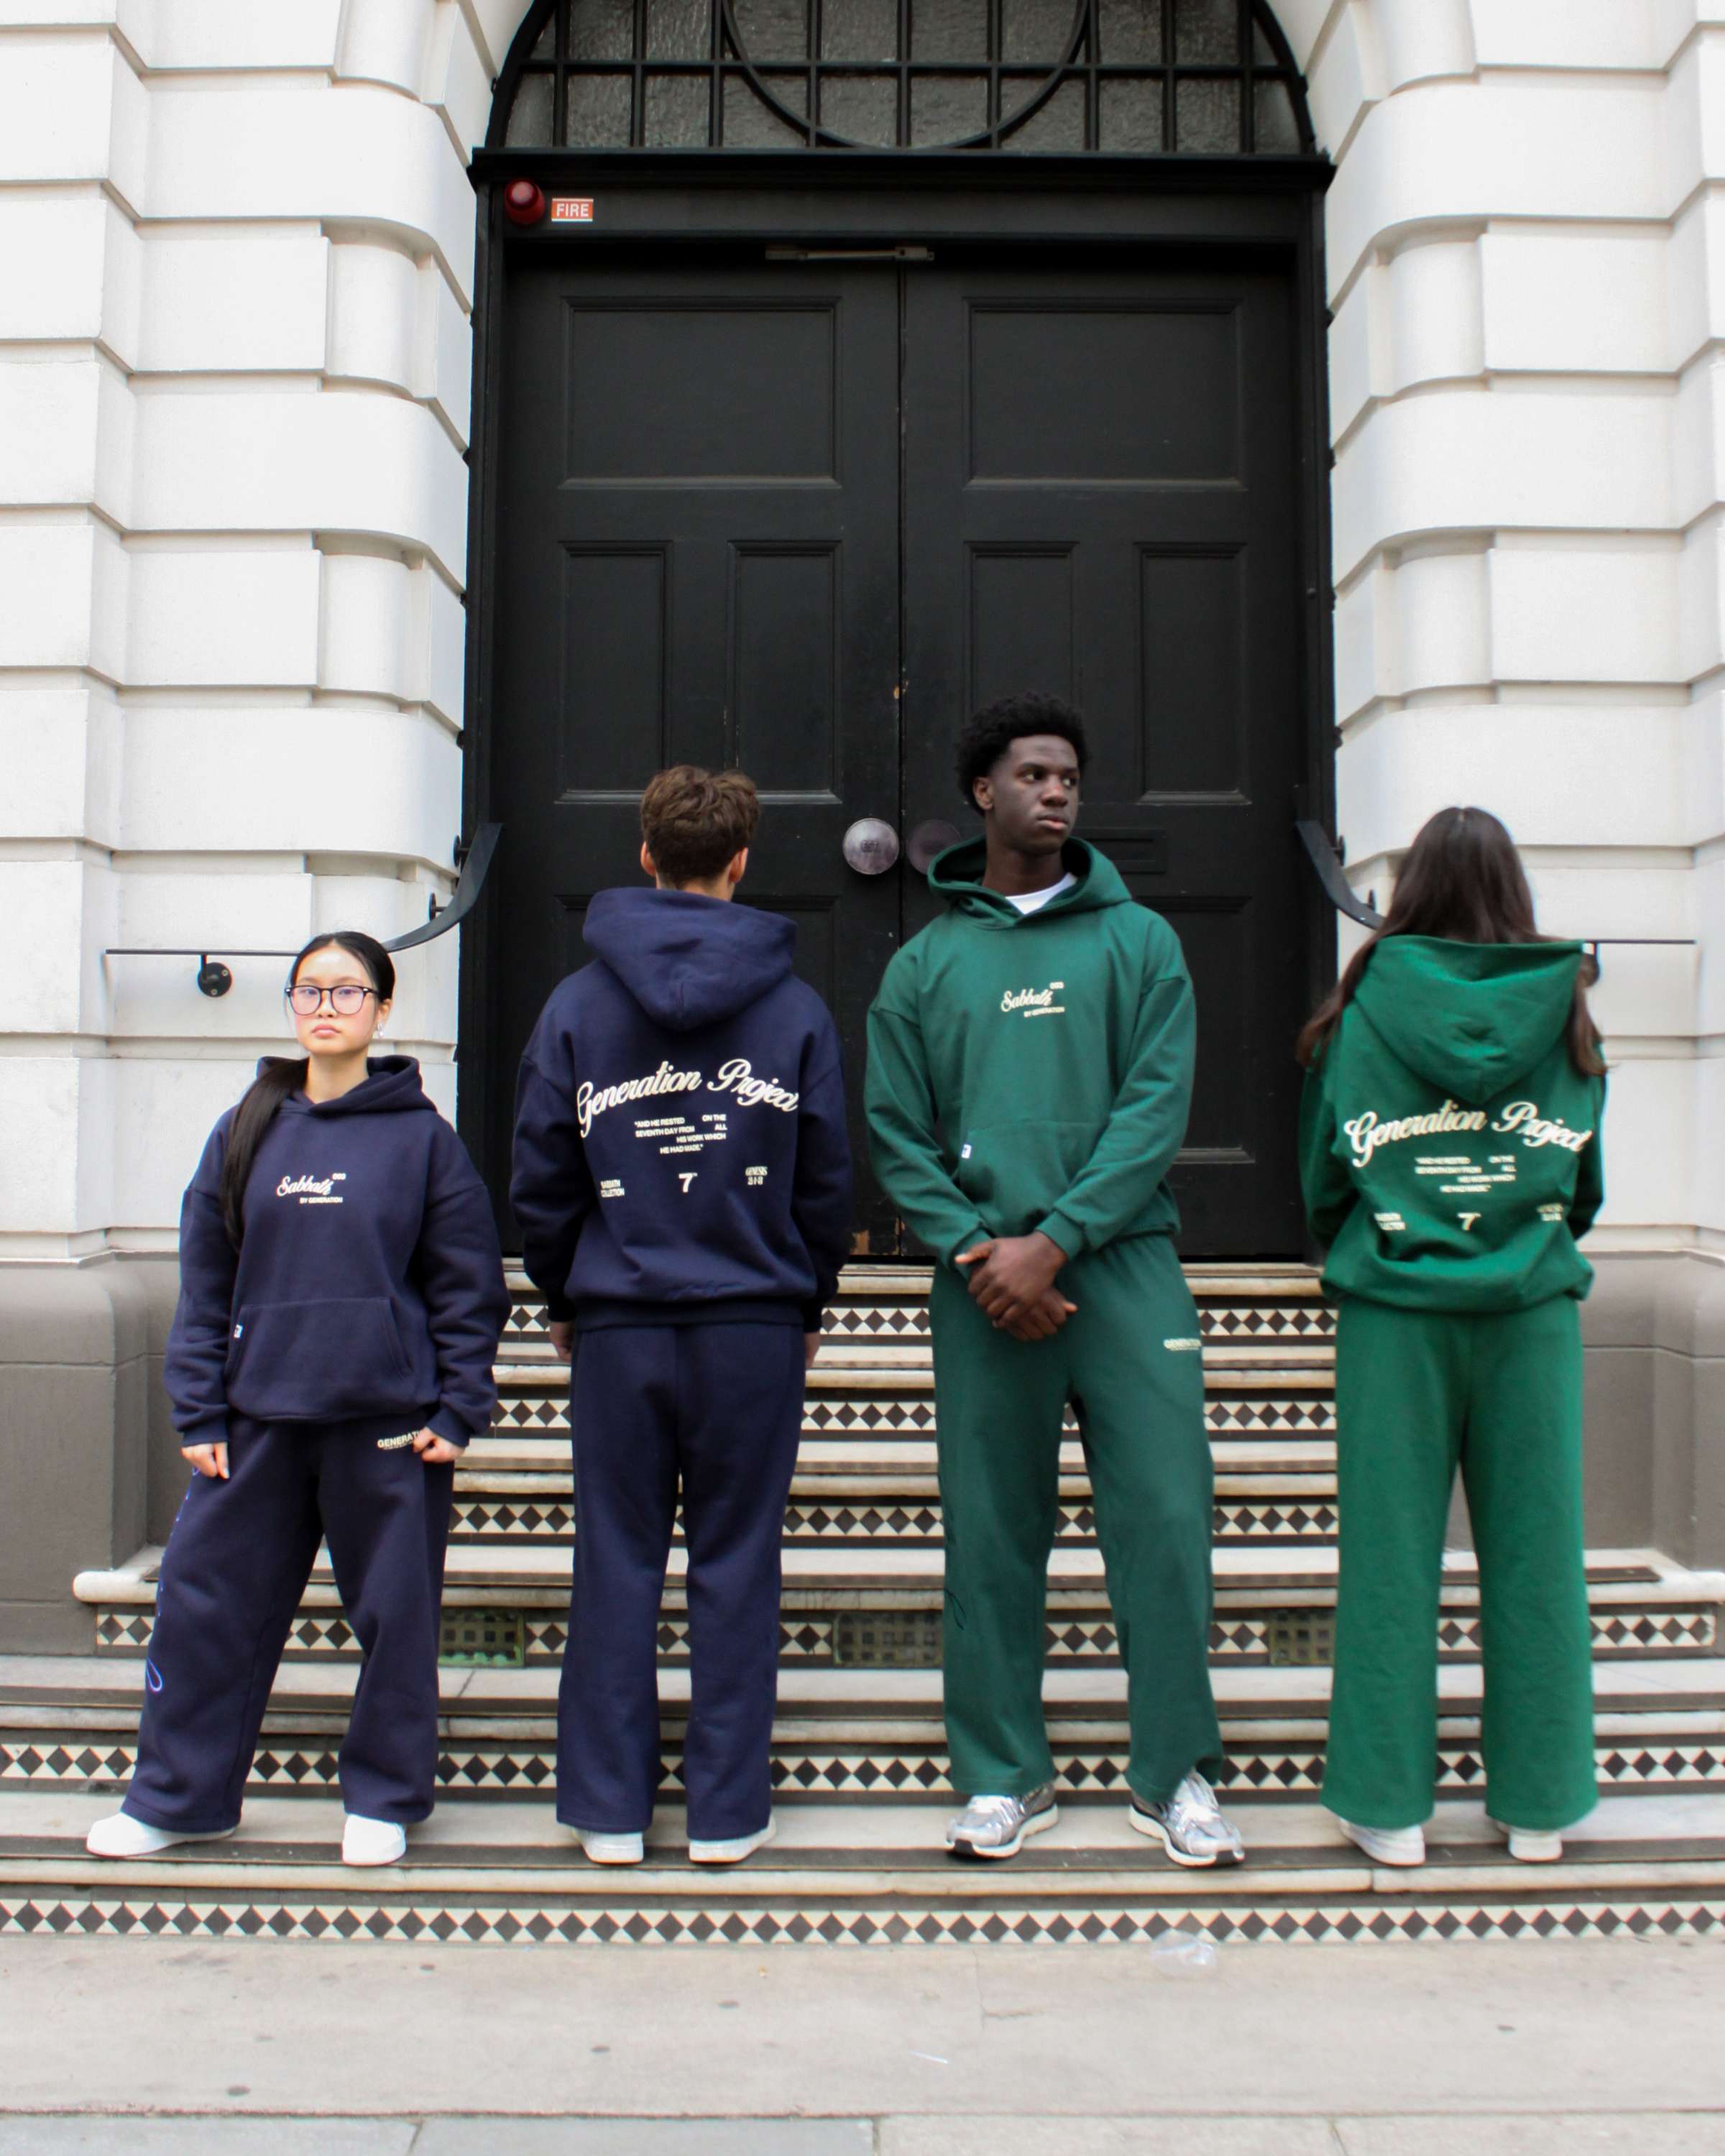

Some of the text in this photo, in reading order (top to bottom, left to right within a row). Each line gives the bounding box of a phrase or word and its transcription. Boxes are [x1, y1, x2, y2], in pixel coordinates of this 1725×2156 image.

[556, 203, 589, 217] FIRE
[1000, 989, 1053, 1012] Sabbath
[576, 1061, 702, 1138] Generation
[1343, 1099, 1592, 1168] Generation Project
[277, 1175, 334, 1197] Sabbath
